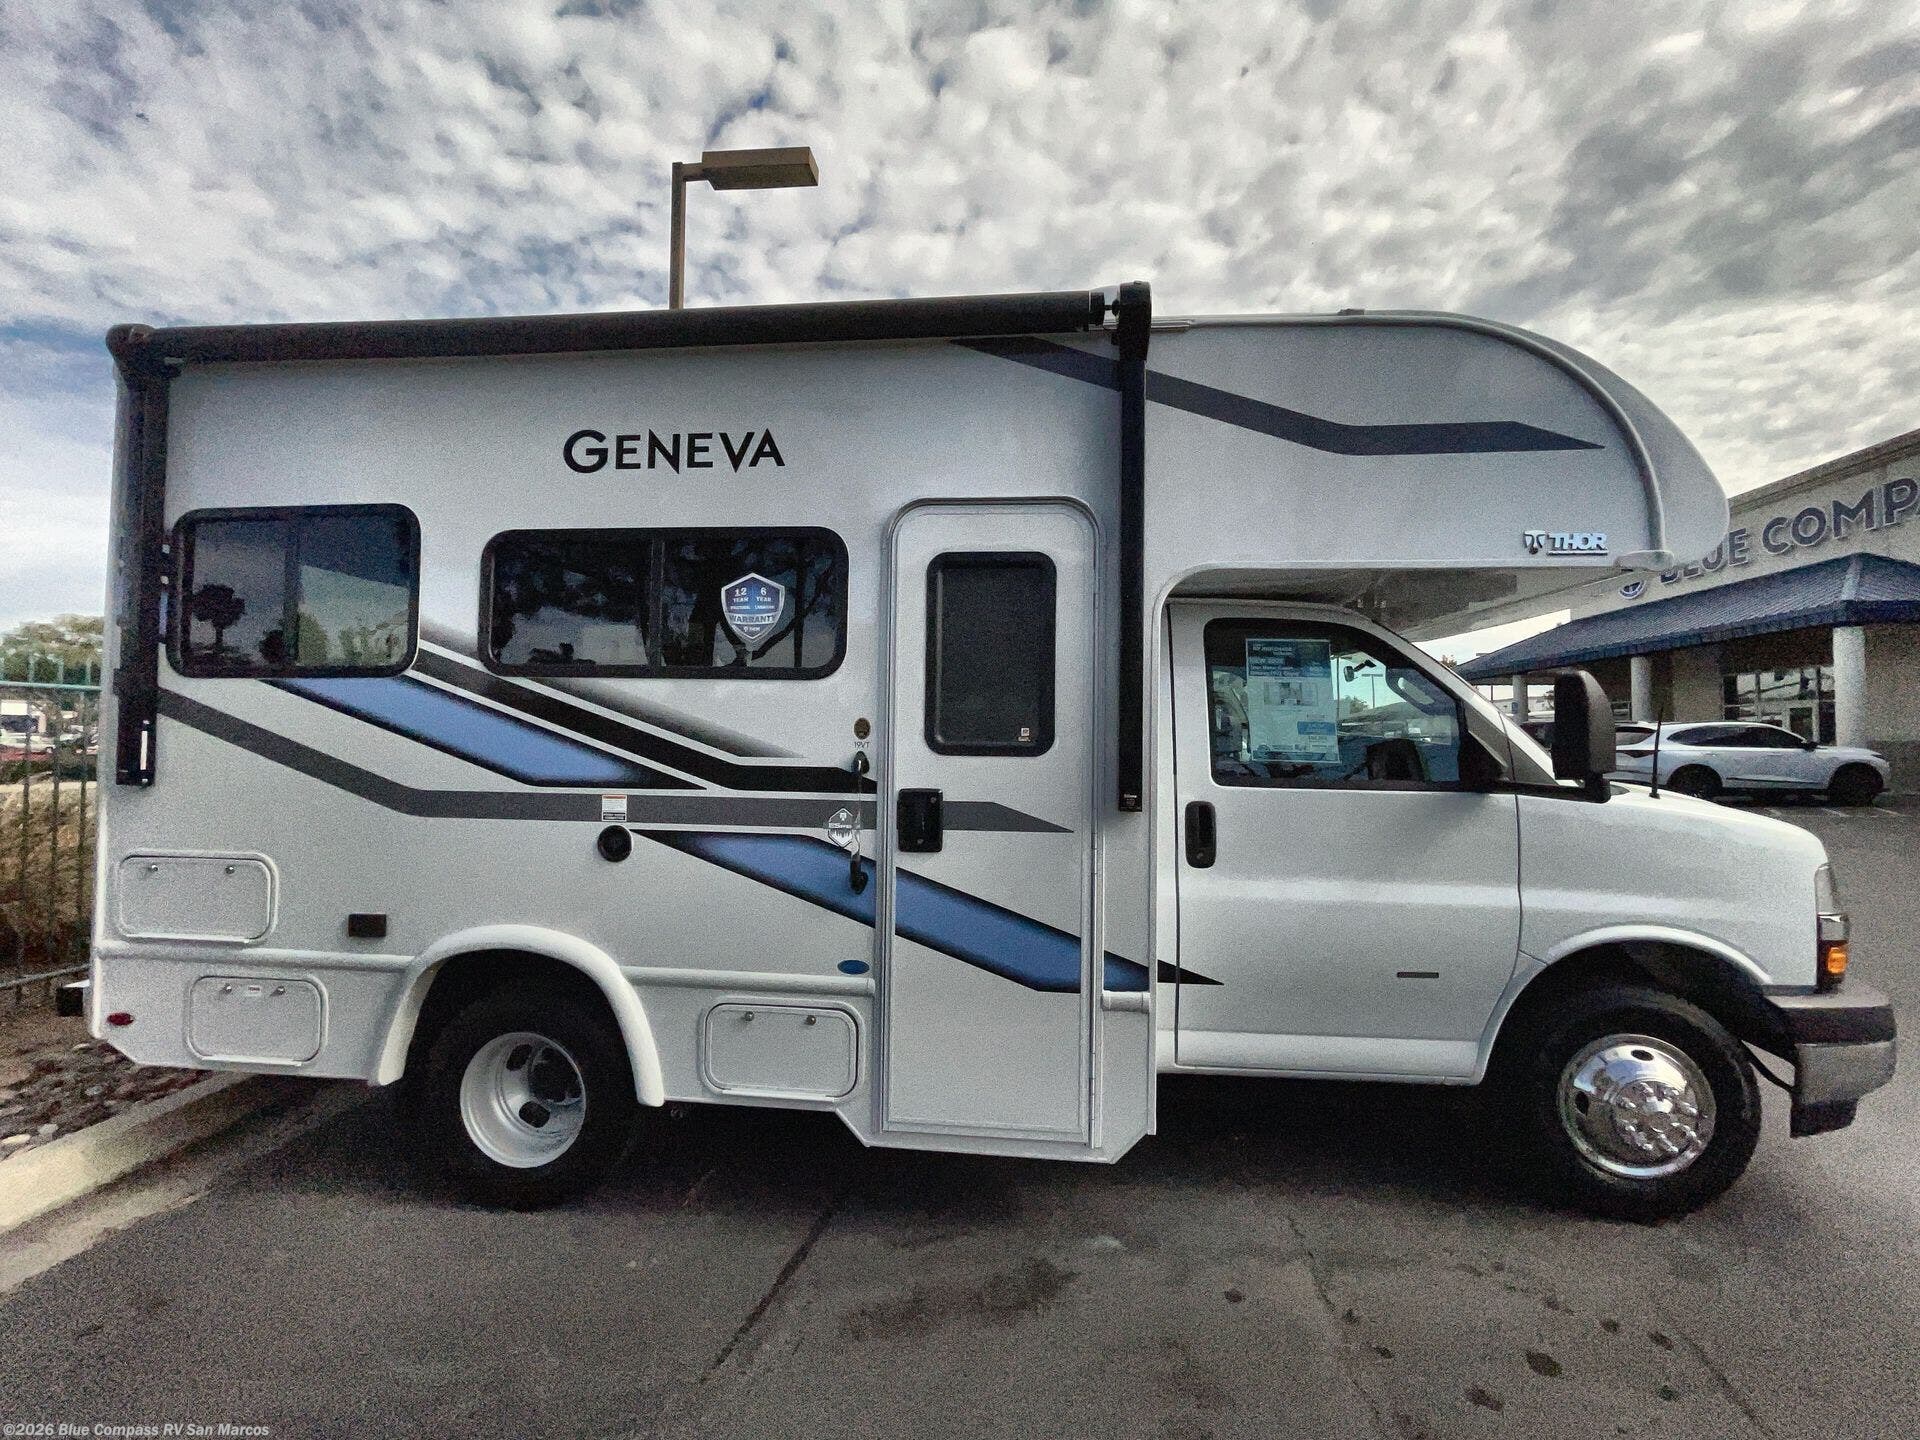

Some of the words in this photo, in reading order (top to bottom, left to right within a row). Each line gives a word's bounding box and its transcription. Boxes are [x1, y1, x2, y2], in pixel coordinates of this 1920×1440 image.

[562, 427, 786, 475] GENEVA
[1762, 478, 1920, 554] COMP
[1547, 531, 1609, 551] THOR
[734, 587, 748, 597] 12
[760, 587, 767, 596] 6
[730, 614, 775, 623] WARRANTY
